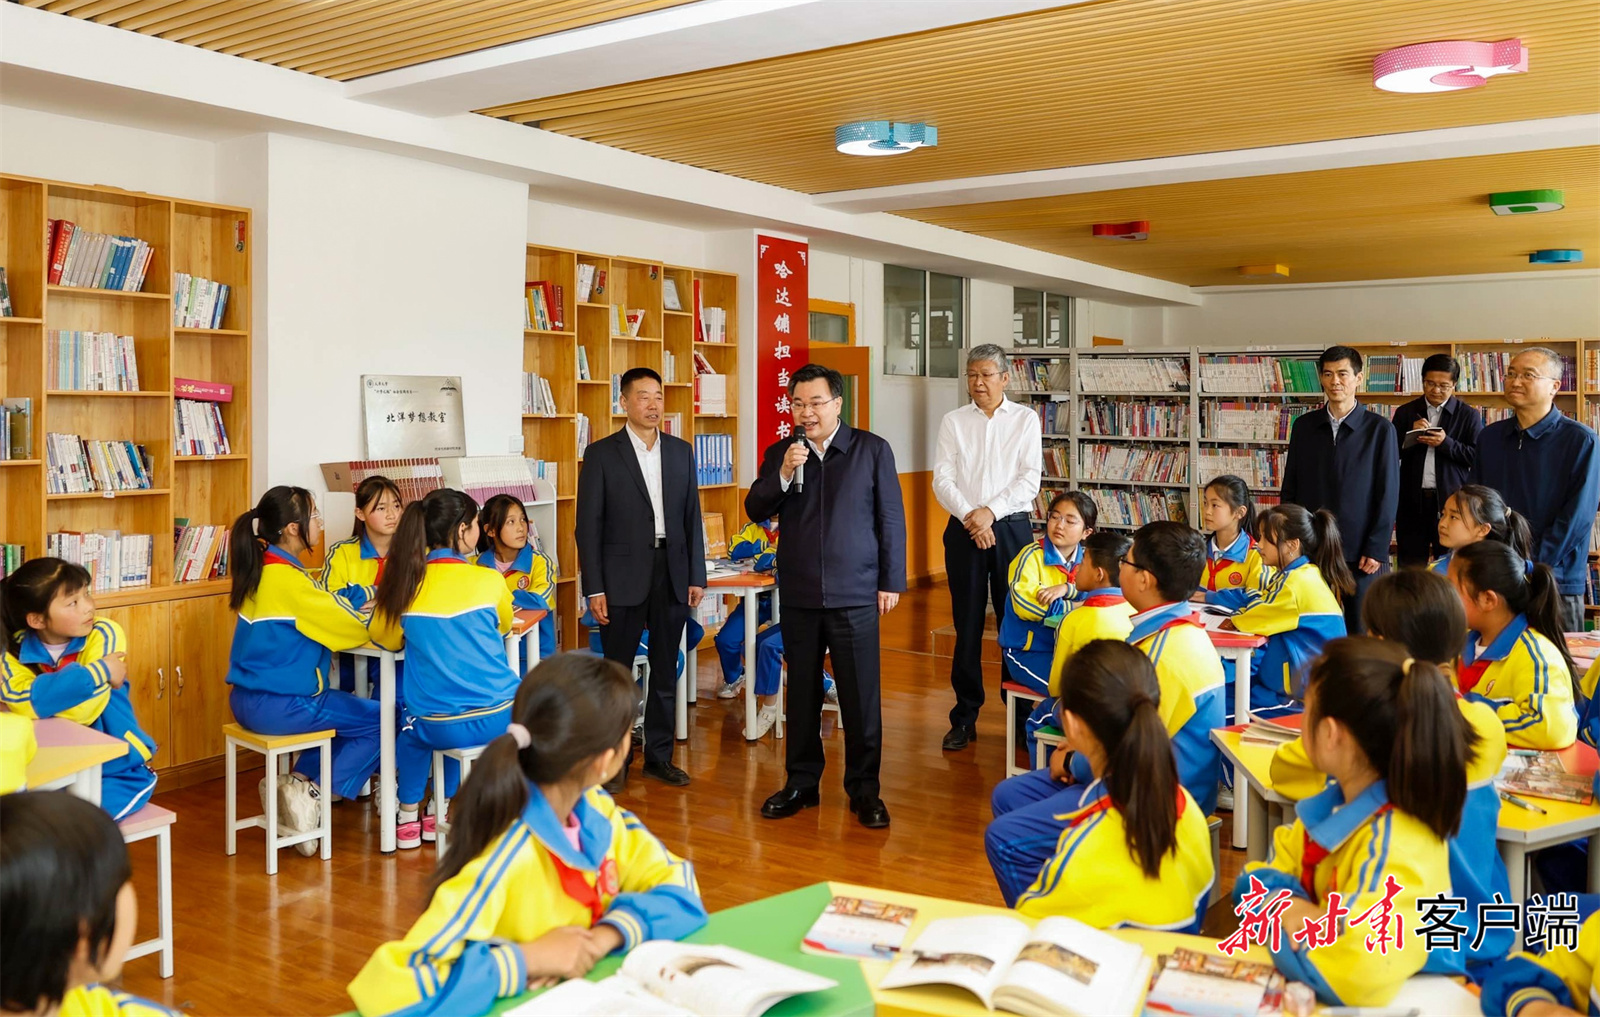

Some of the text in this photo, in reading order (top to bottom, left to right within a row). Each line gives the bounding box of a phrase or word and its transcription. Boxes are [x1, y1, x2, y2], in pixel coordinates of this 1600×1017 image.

[386, 411, 446, 423] 北洋梦想教室
